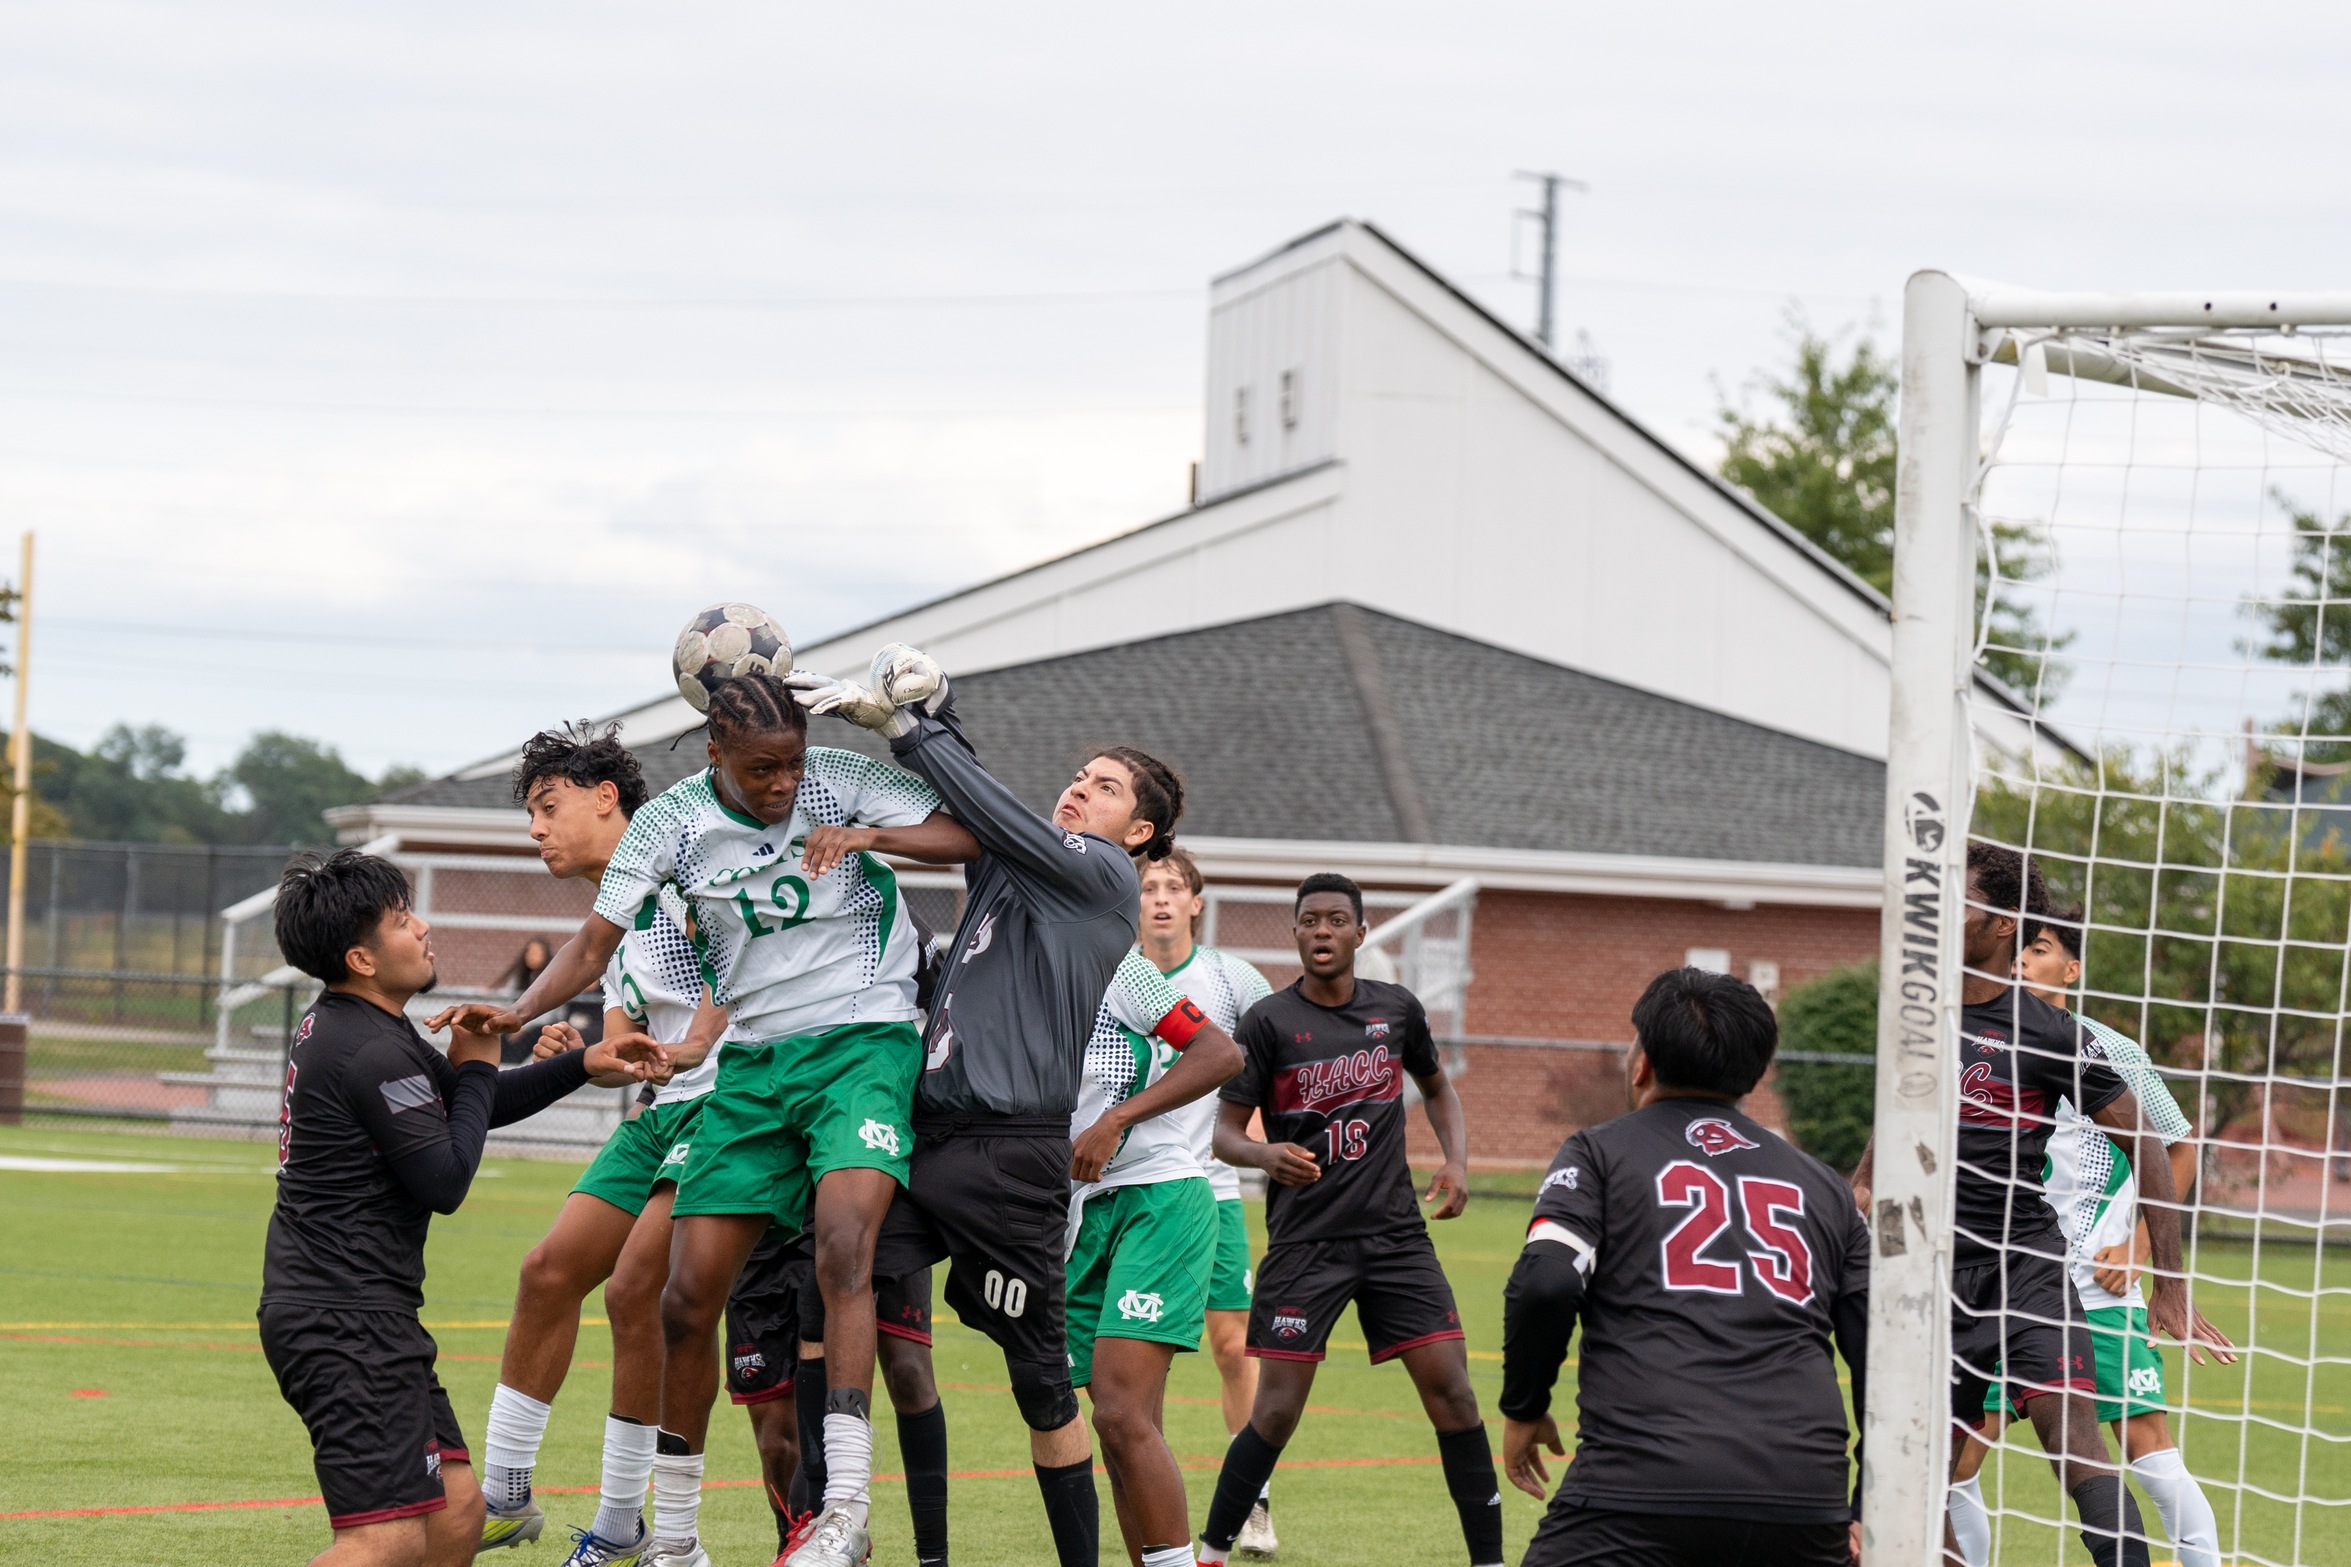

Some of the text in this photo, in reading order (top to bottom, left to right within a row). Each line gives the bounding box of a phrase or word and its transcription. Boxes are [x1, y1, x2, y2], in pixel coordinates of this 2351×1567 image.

[731, 874, 817, 939] 12
[1180, 1000, 1206, 1024] C
[1297, 1044, 1393, 1104] HACC
[1324, 1119, 1371, 1166] 18
[1655, 1159, 1817, 1307] 25
[983, 1268, 1028, 1319] 00
[1270, 1315, 1308, 1334] HAWKS
